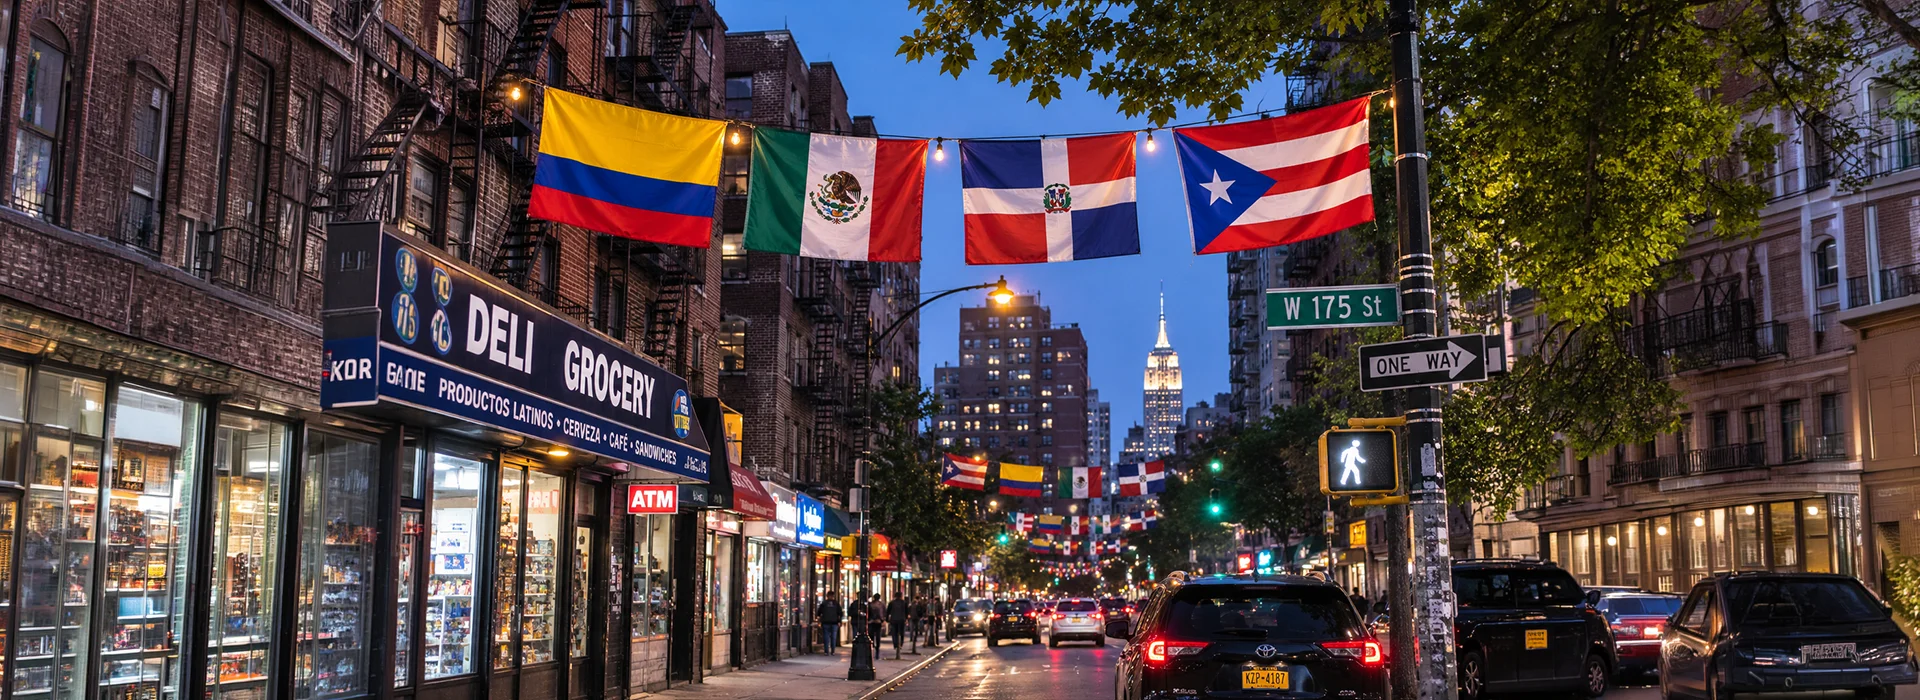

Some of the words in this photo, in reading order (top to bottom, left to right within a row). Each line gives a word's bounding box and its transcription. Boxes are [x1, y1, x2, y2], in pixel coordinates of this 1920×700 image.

[1284, 296, 1300, 320] W
[1312, 295, 1352, 320] 175
[1362, 294, 1382, 318] St
[466, 293, 535, 375] DELI
[564, 339, 656, 419] GROCERY
[1376, 356, 1411, 375] ONE
[1426, 351, 1462, 370] WAY
[438, 377, 509, 417] PRODUCTOS
[513, 401, 554, 430] LATINOS
[564, 418, 601, 443] CERVEZA
[609, 432, 628, 452] CAFÉ
[635, 440, 677, 465] SANDWICHES
[631, 490, 674, 508] ATM
[1245, 672, 1285, 685] KZP-4187
